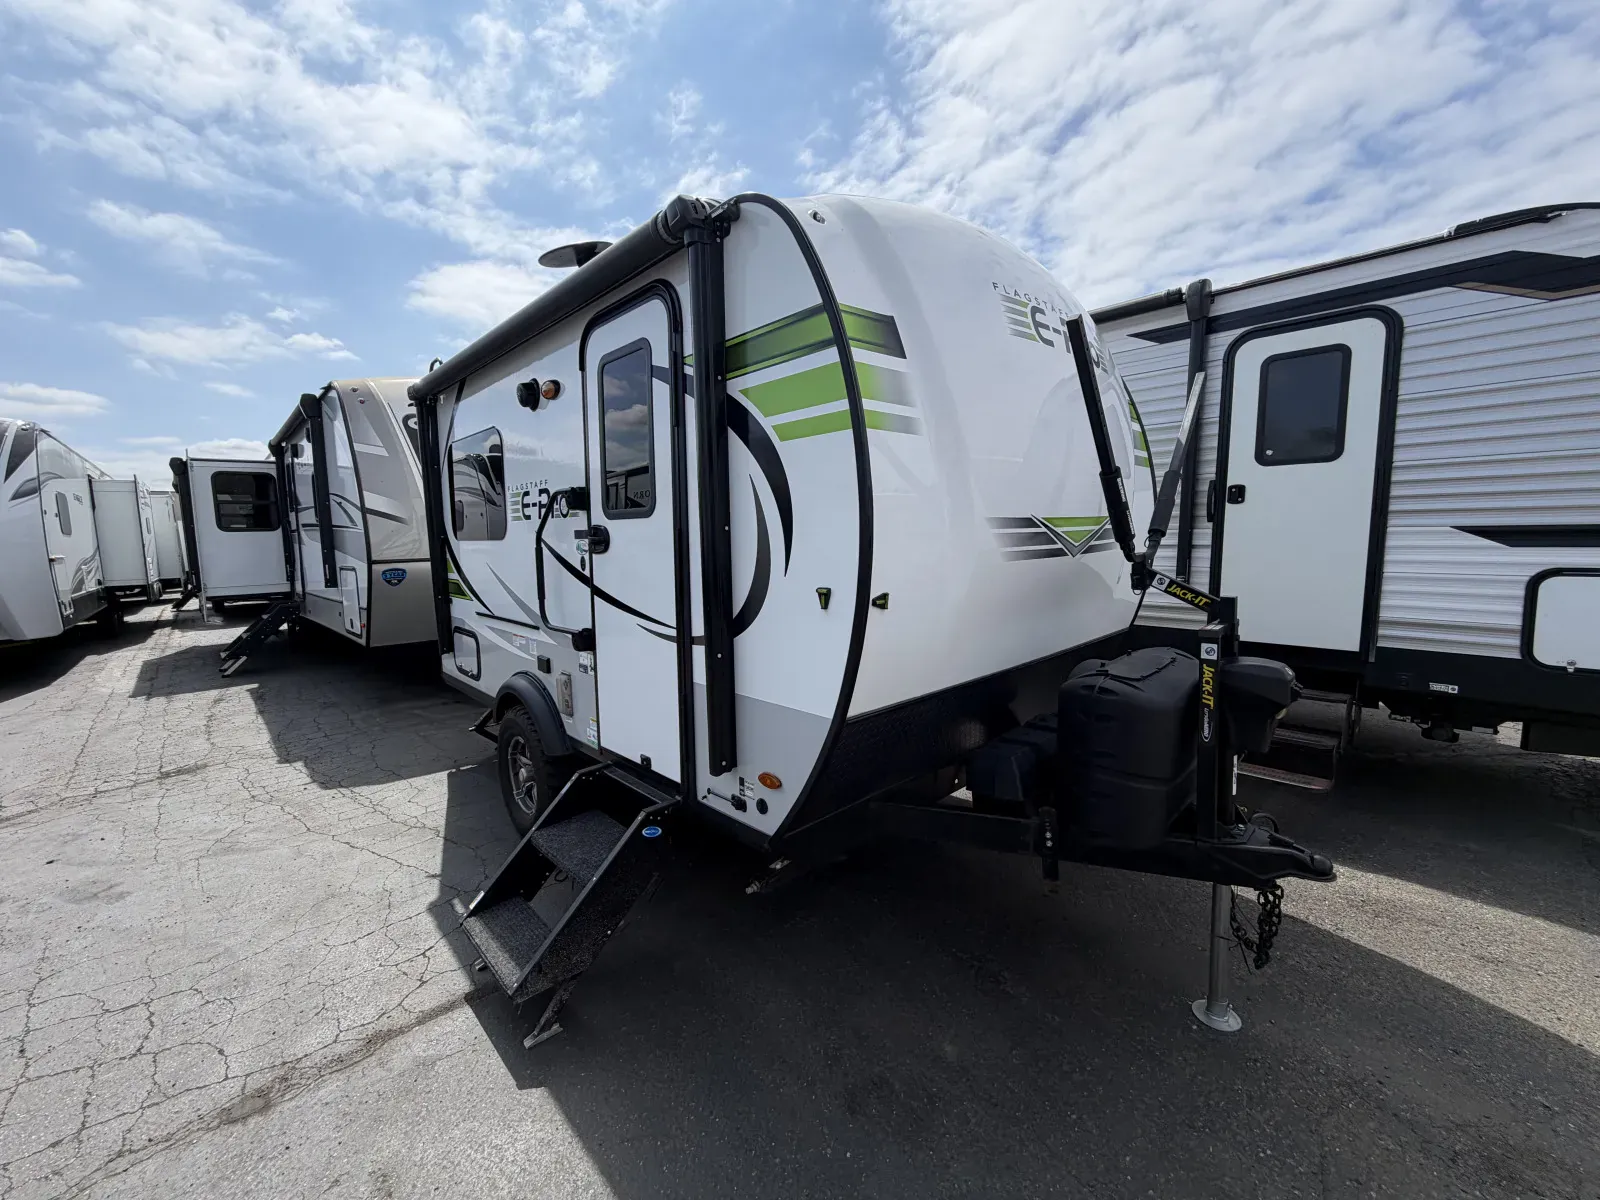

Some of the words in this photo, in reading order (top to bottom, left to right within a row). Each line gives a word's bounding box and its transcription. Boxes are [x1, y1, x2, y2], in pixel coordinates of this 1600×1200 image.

[508, 479, 548, 492] FLAGSTAFF
[1167, 583, 1212, 607] JACK-IT
[1202, 664, 1215, 709] JACK-IT
